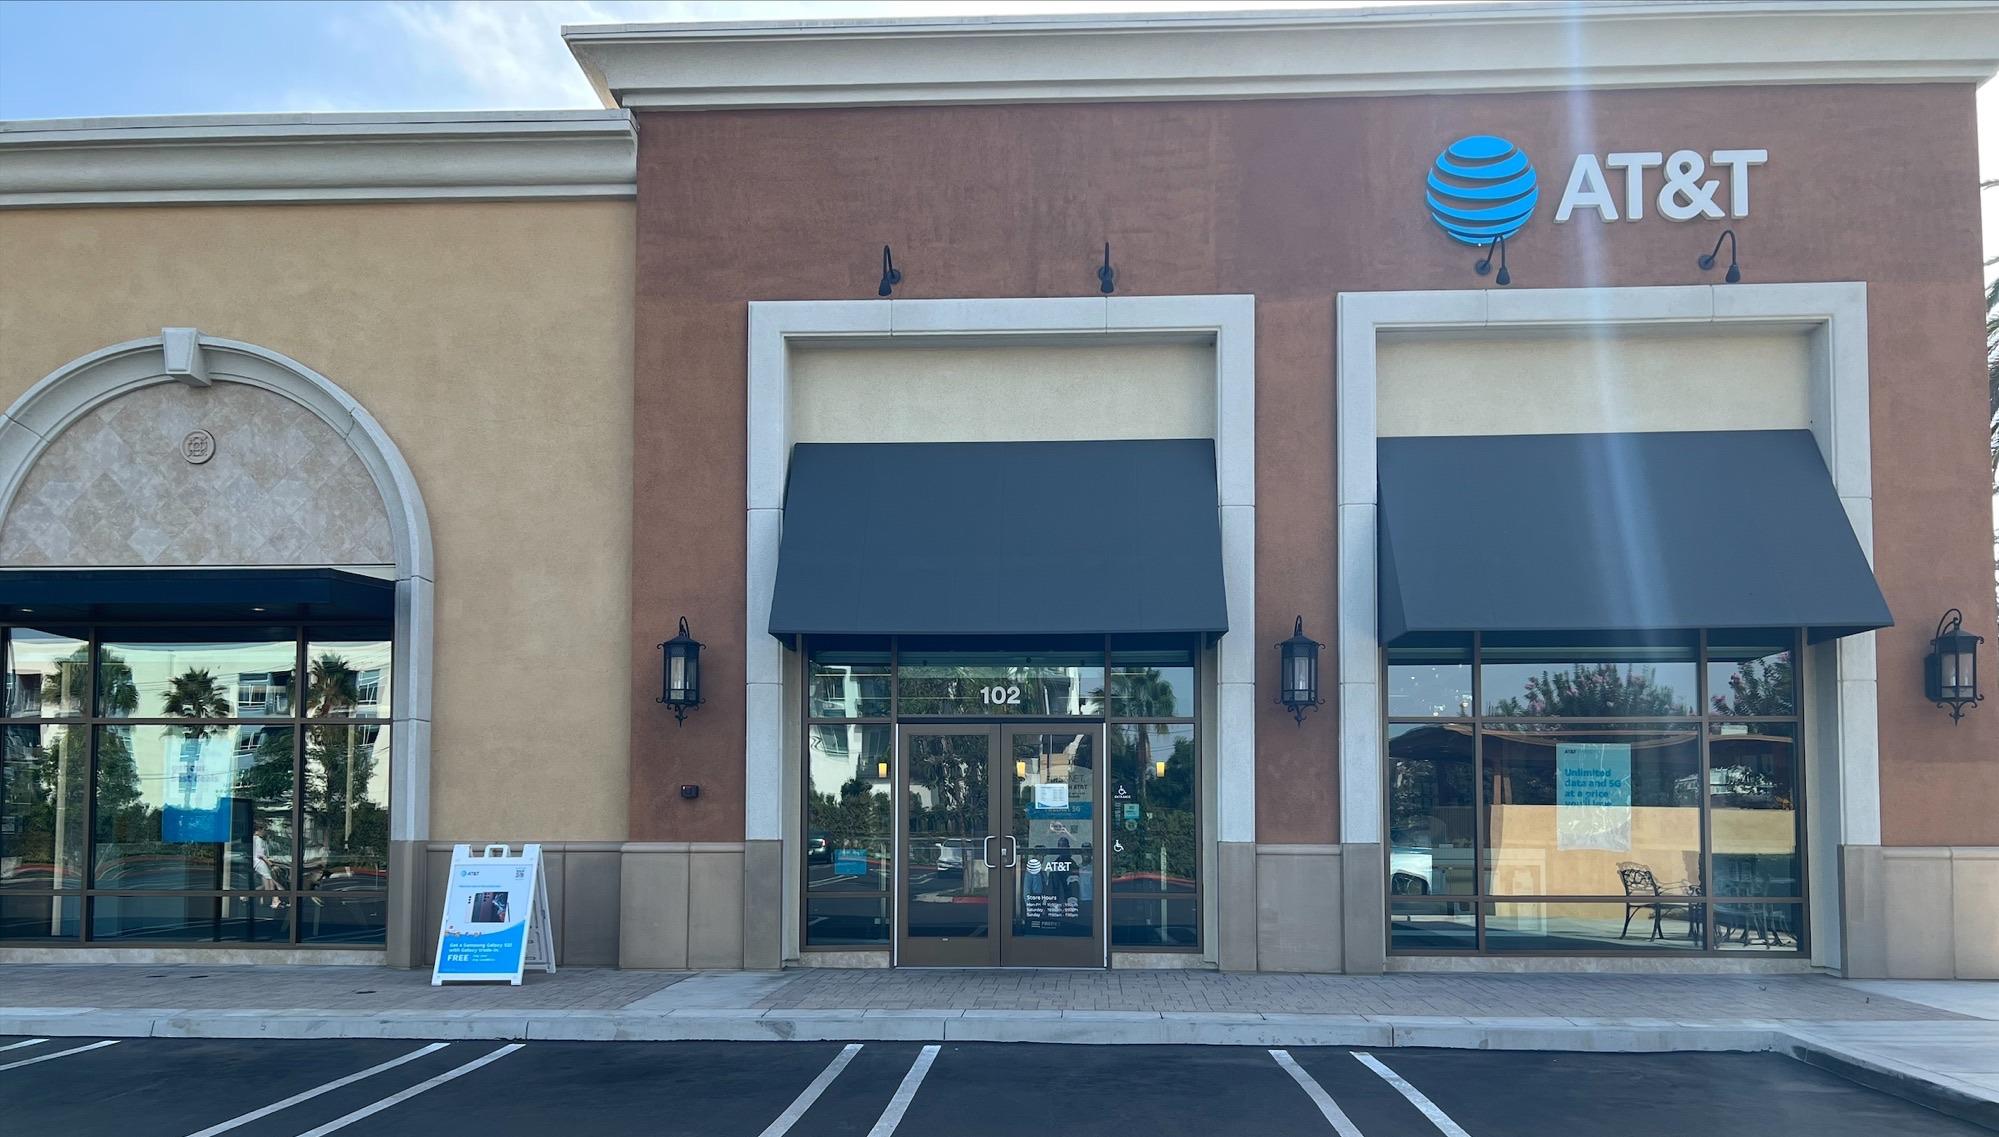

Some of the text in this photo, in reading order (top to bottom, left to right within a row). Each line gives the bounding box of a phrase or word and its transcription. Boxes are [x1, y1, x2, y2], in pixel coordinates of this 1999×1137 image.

[1553, 149, 1768, 223] AT&T
[980, 686, 1021, 704] 102
[1564, 768, 1612, 777] Unlimited
[1564, 778, 1621, 788] data and 5G
[1564, 789, 1574, 798] at
[1585, 788, 1609, 800] price
[1044, 861, 1072, 872] AT&T
[447, 954, 469, 962] FREE
